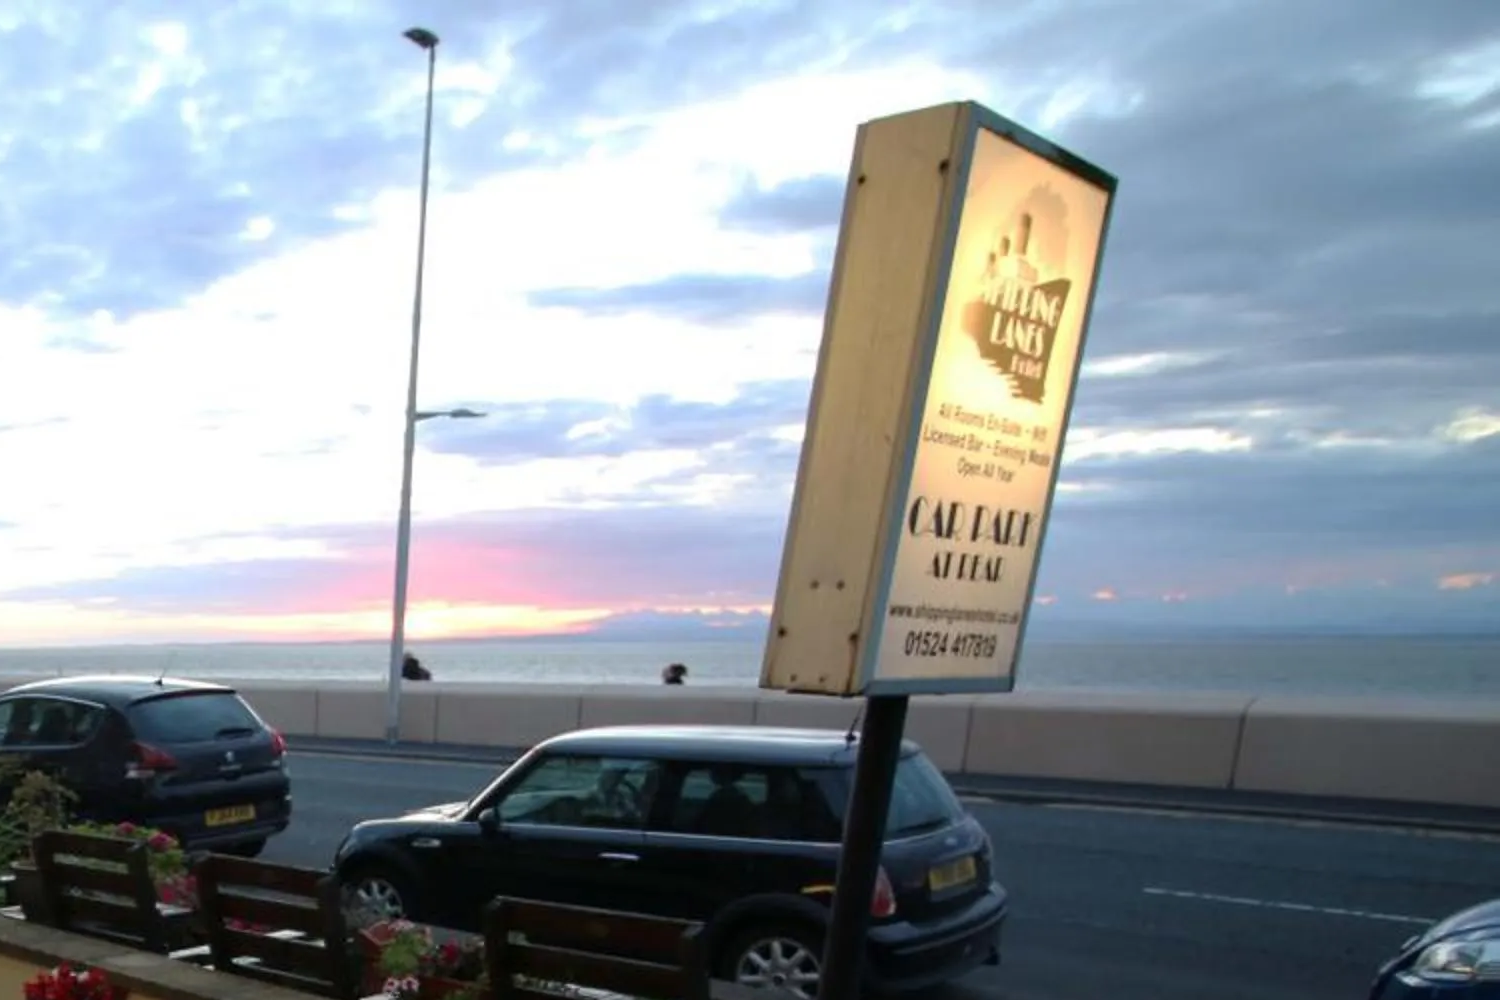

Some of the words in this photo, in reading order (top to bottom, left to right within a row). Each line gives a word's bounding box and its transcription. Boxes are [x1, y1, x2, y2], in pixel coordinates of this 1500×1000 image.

[980, 280, 1062, 329] HIPPING
[990, 311, 1044, 358] LANES
[939, 403, 953, 418] All
[954, 406, 985, 428] Rooms
[922, 423, 966, 448] Licensed
[967, 433, 984, 451] Bar
[993, 440, 1027, 465] Evening
[957, 457, 982, 478] Open
[983, 463, 995, 477] All
[997, 465, 1015, 482] Year
[908, 495, 963, 542] CAR
[970, 504, 1037, 547] PARK
[925, 552, 953, 579] AT
[957, 554, 1004, 582] REAR
[904, 630, 948, 657] 01524
